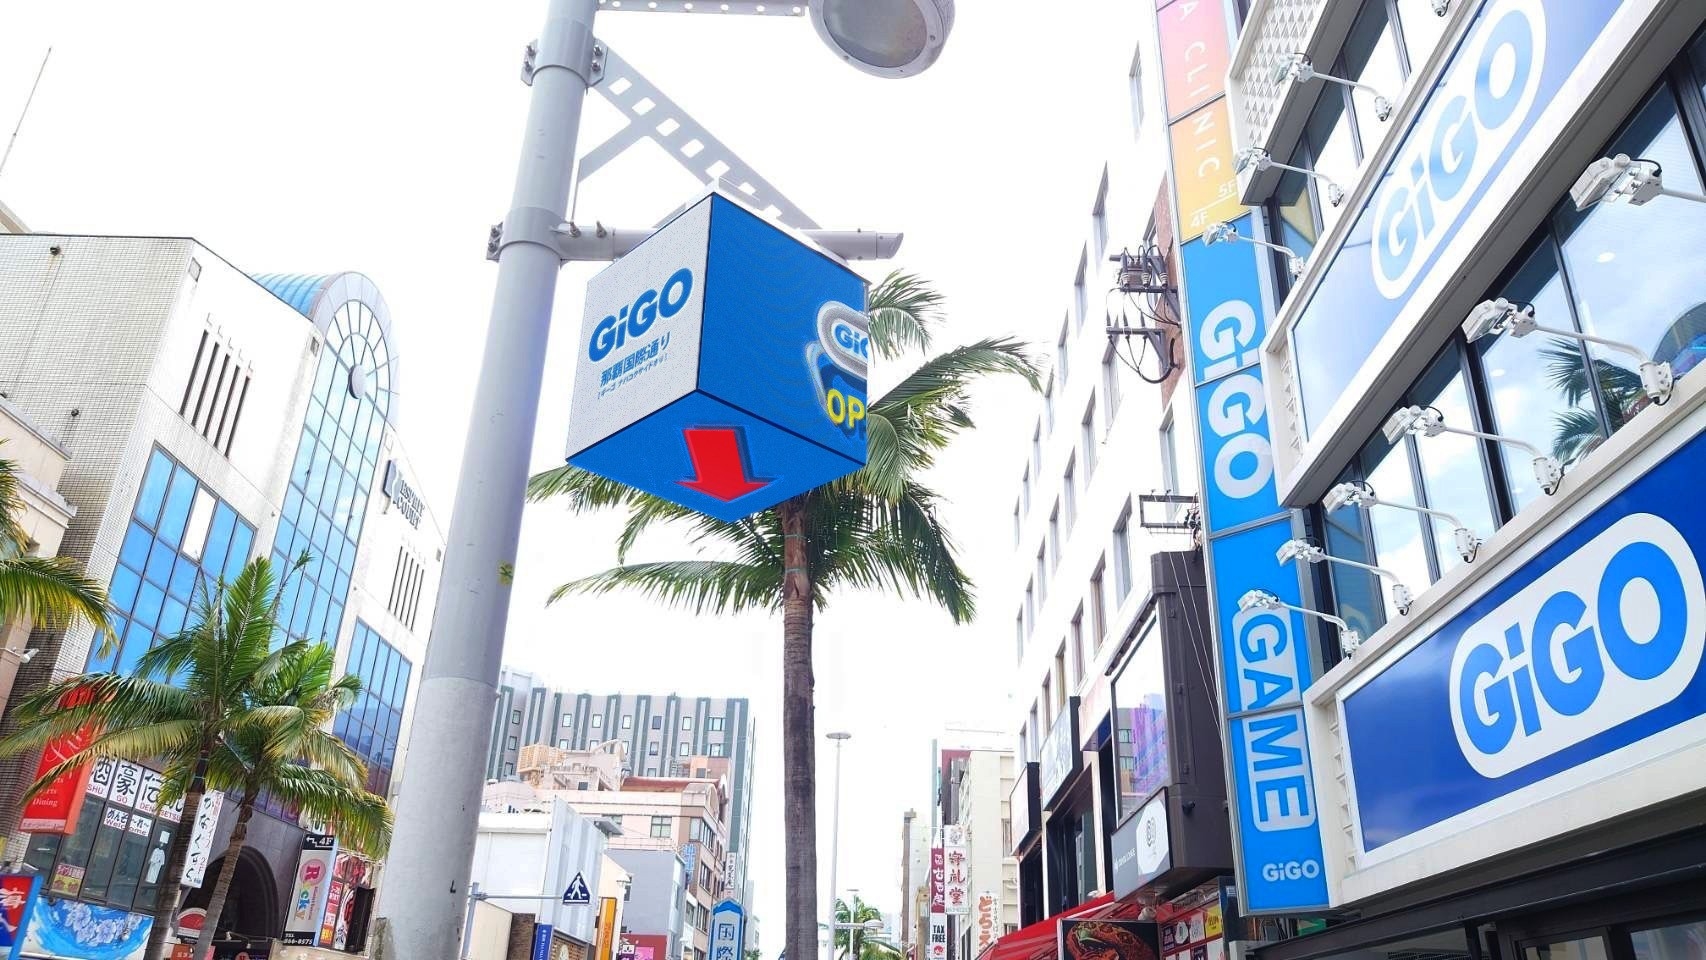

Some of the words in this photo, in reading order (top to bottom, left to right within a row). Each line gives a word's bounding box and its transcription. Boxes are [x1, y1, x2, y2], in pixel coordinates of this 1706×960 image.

[1184, 41, 1220, 178] CLINIC
[1379, 10, 1533, 281] GiGO
[1218, 180, 1237, 198] 5F
[1190, 211, 1208, 228] 4F
[588, 267, 693, 362] GiGO
[600, 331, 671, 387] 那覇国際通り
[1200, 300, 1273, 499] GiGO
[1459, 541, 1688, 755] GiGO
[1240, 613, 1309, 823] GAME
[116, 794, 128, 804] GO
[318, 836, 334, 846] 4F
[948, 850, 966, 905] 守礼堂
[1262, 859, 1320, 882] GiGO
[931, 934, 946, 943] FREE
[933, 924, 945, 933] TAX
